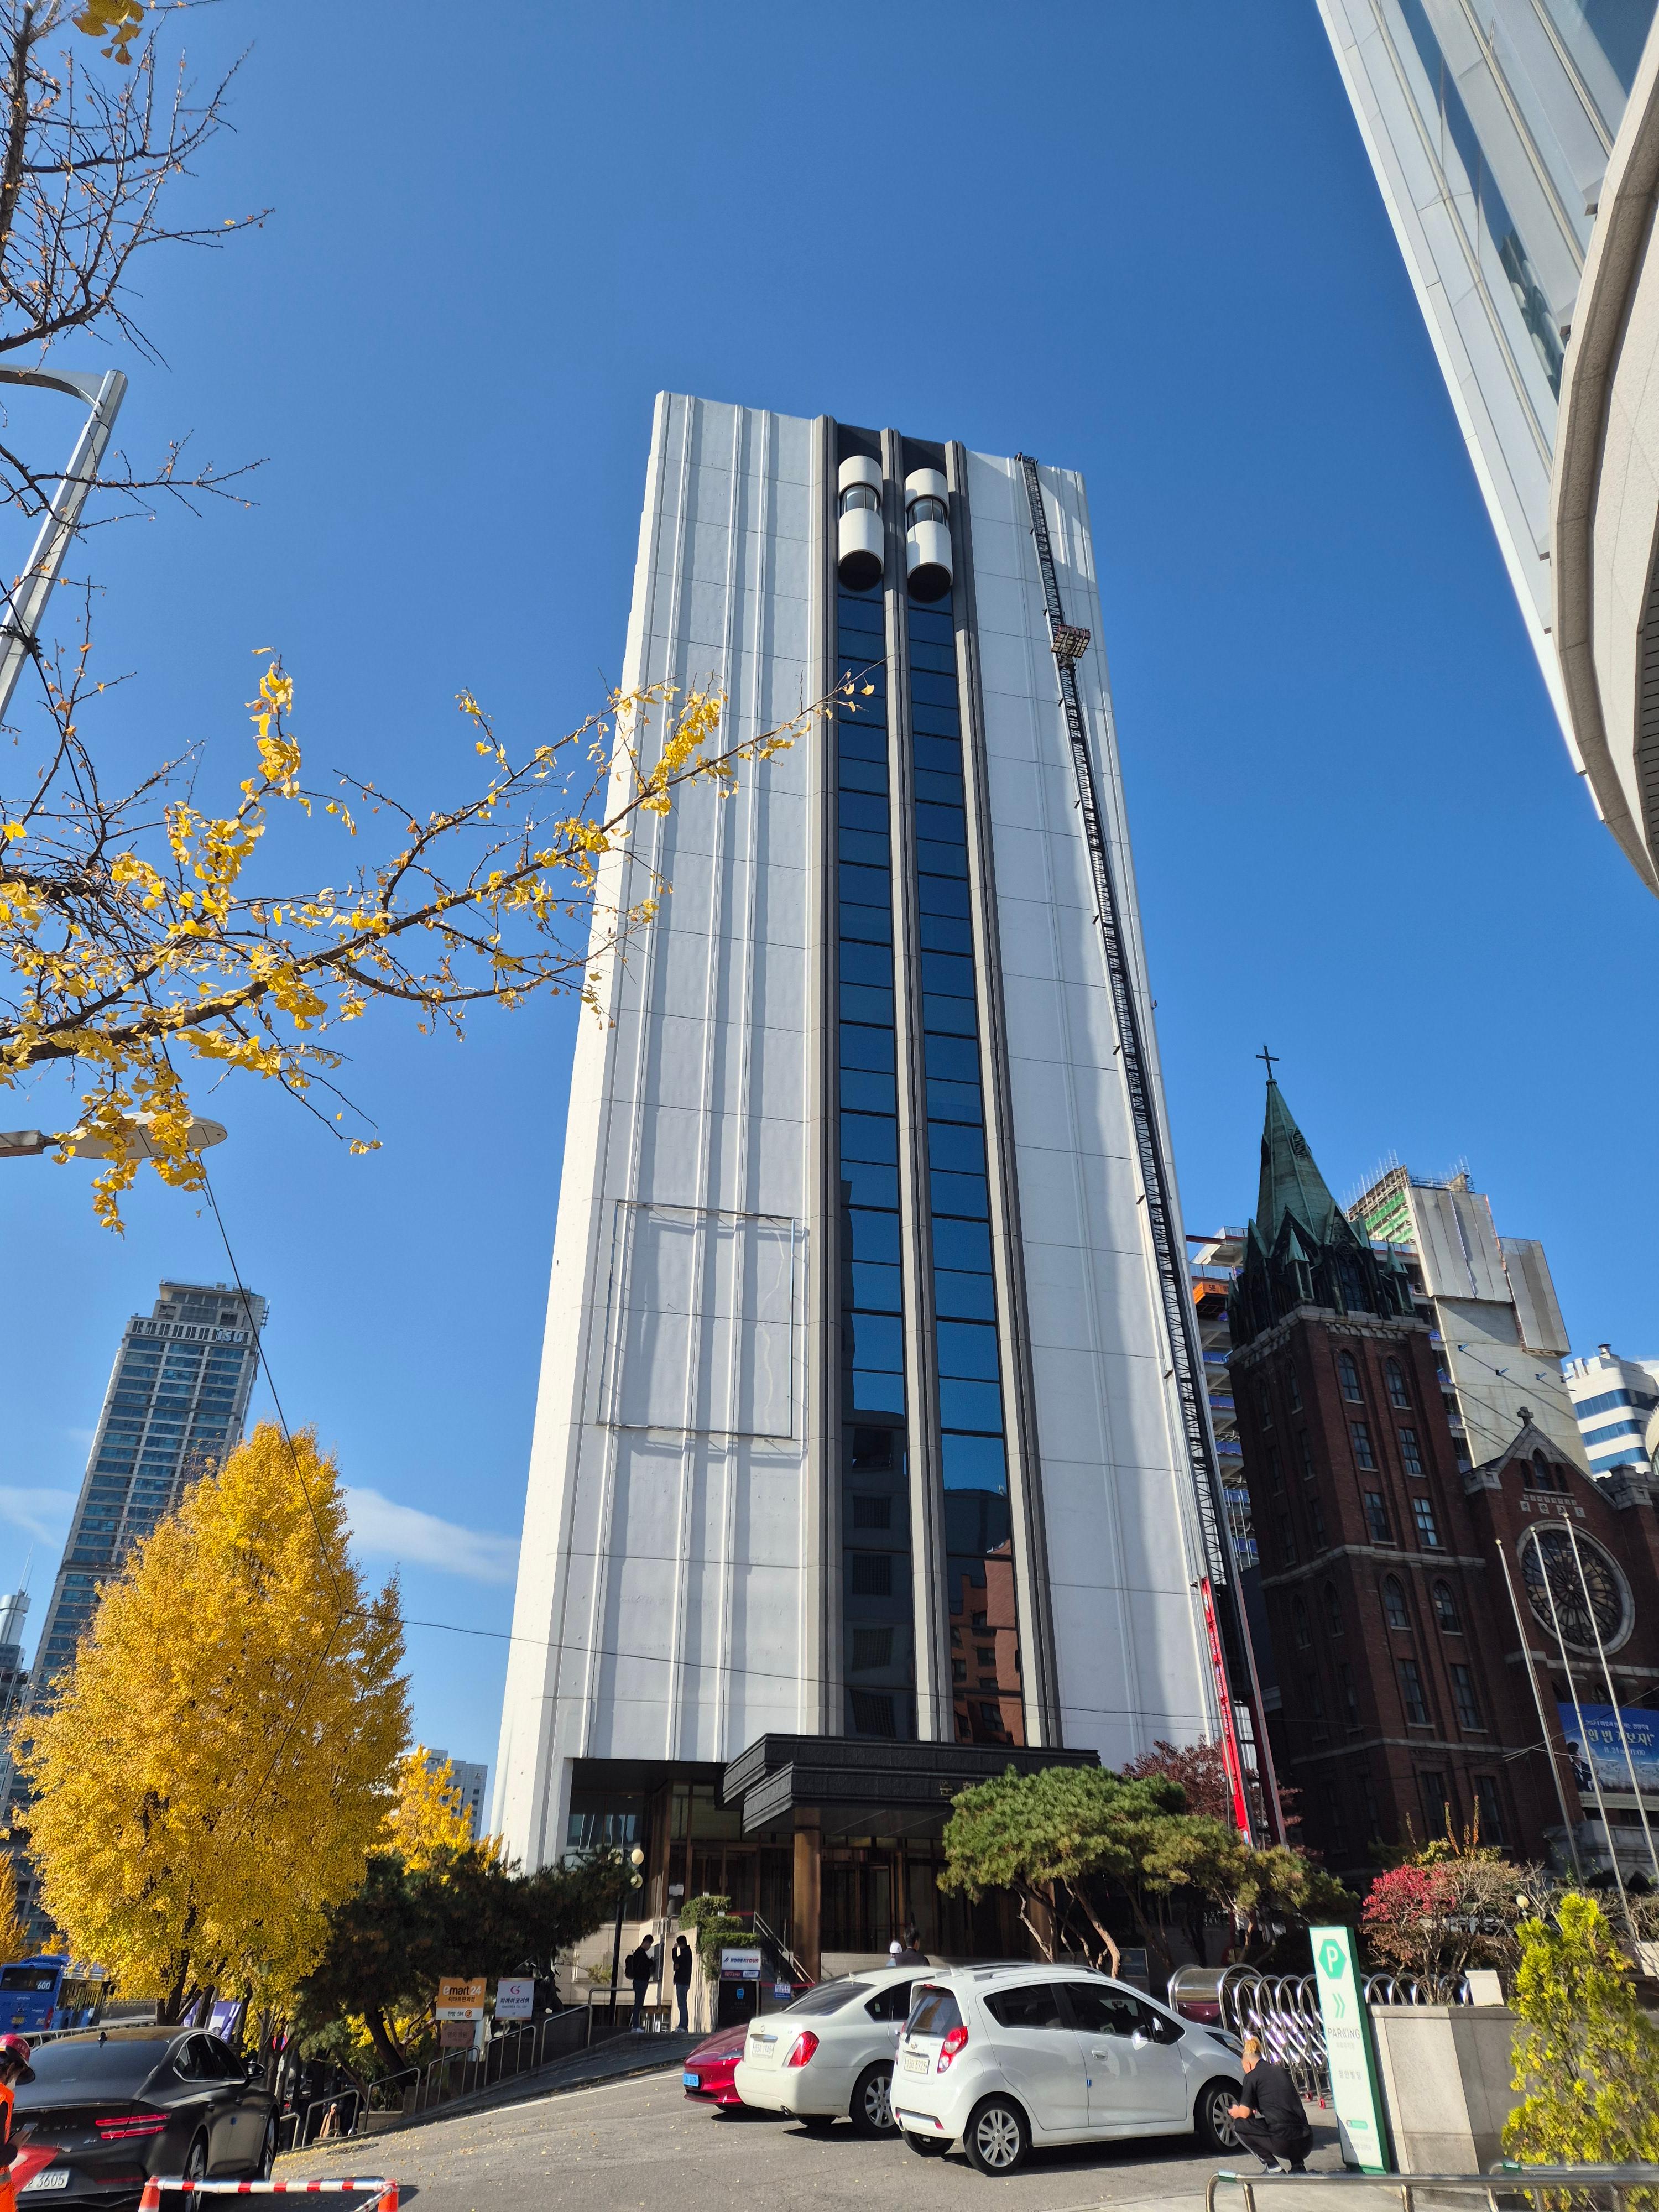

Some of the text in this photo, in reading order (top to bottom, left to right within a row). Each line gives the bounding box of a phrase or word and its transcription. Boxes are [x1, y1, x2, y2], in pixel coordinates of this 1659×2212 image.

[217, 1329, 243, 1343] ISU
[37, 1981, 51, 1990] 600
[39, 2174, 64, 2188] 3605
